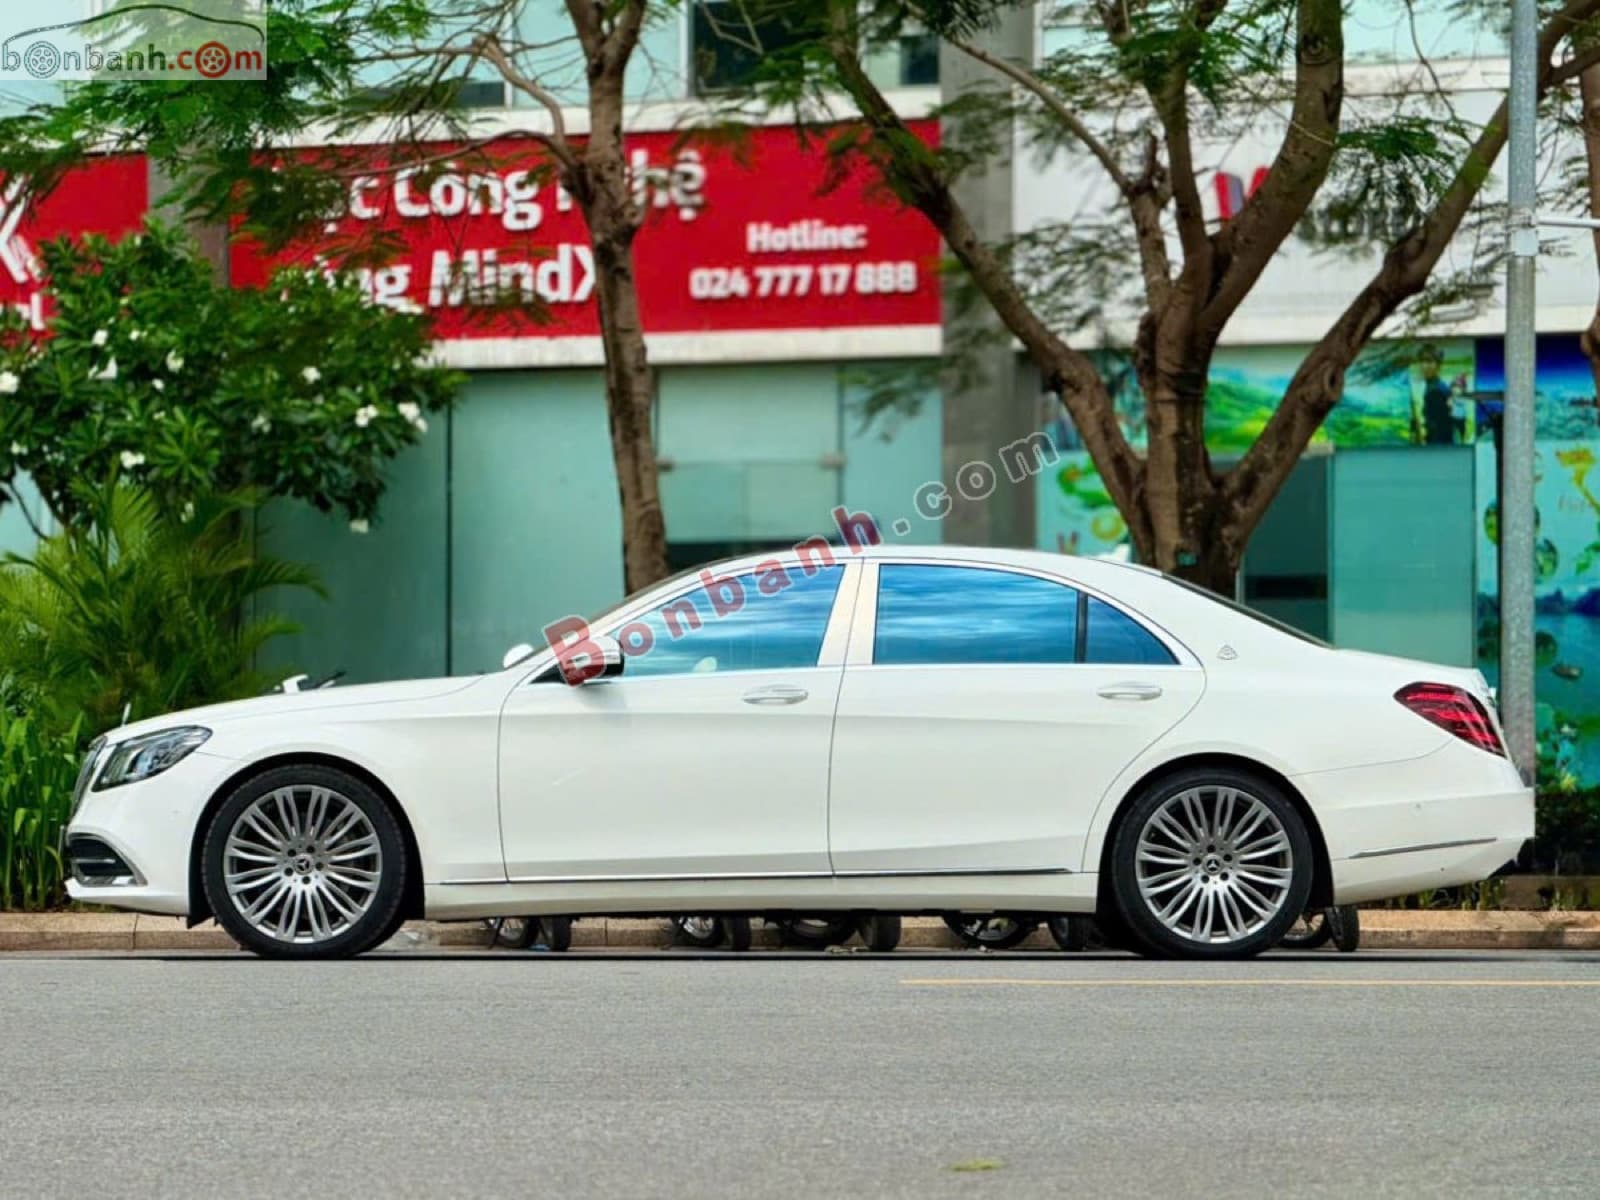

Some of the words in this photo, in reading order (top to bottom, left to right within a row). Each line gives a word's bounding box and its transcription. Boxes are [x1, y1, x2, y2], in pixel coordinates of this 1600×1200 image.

[556, 149, 705, 221] hệ
[746, 218, 868, 252] Hotline:
[689, 267, 750, 299] 024
[754, 265, 814, 297] 777
[817, 264, 852, 295] 17
[854, 261, 918, 293] 888
